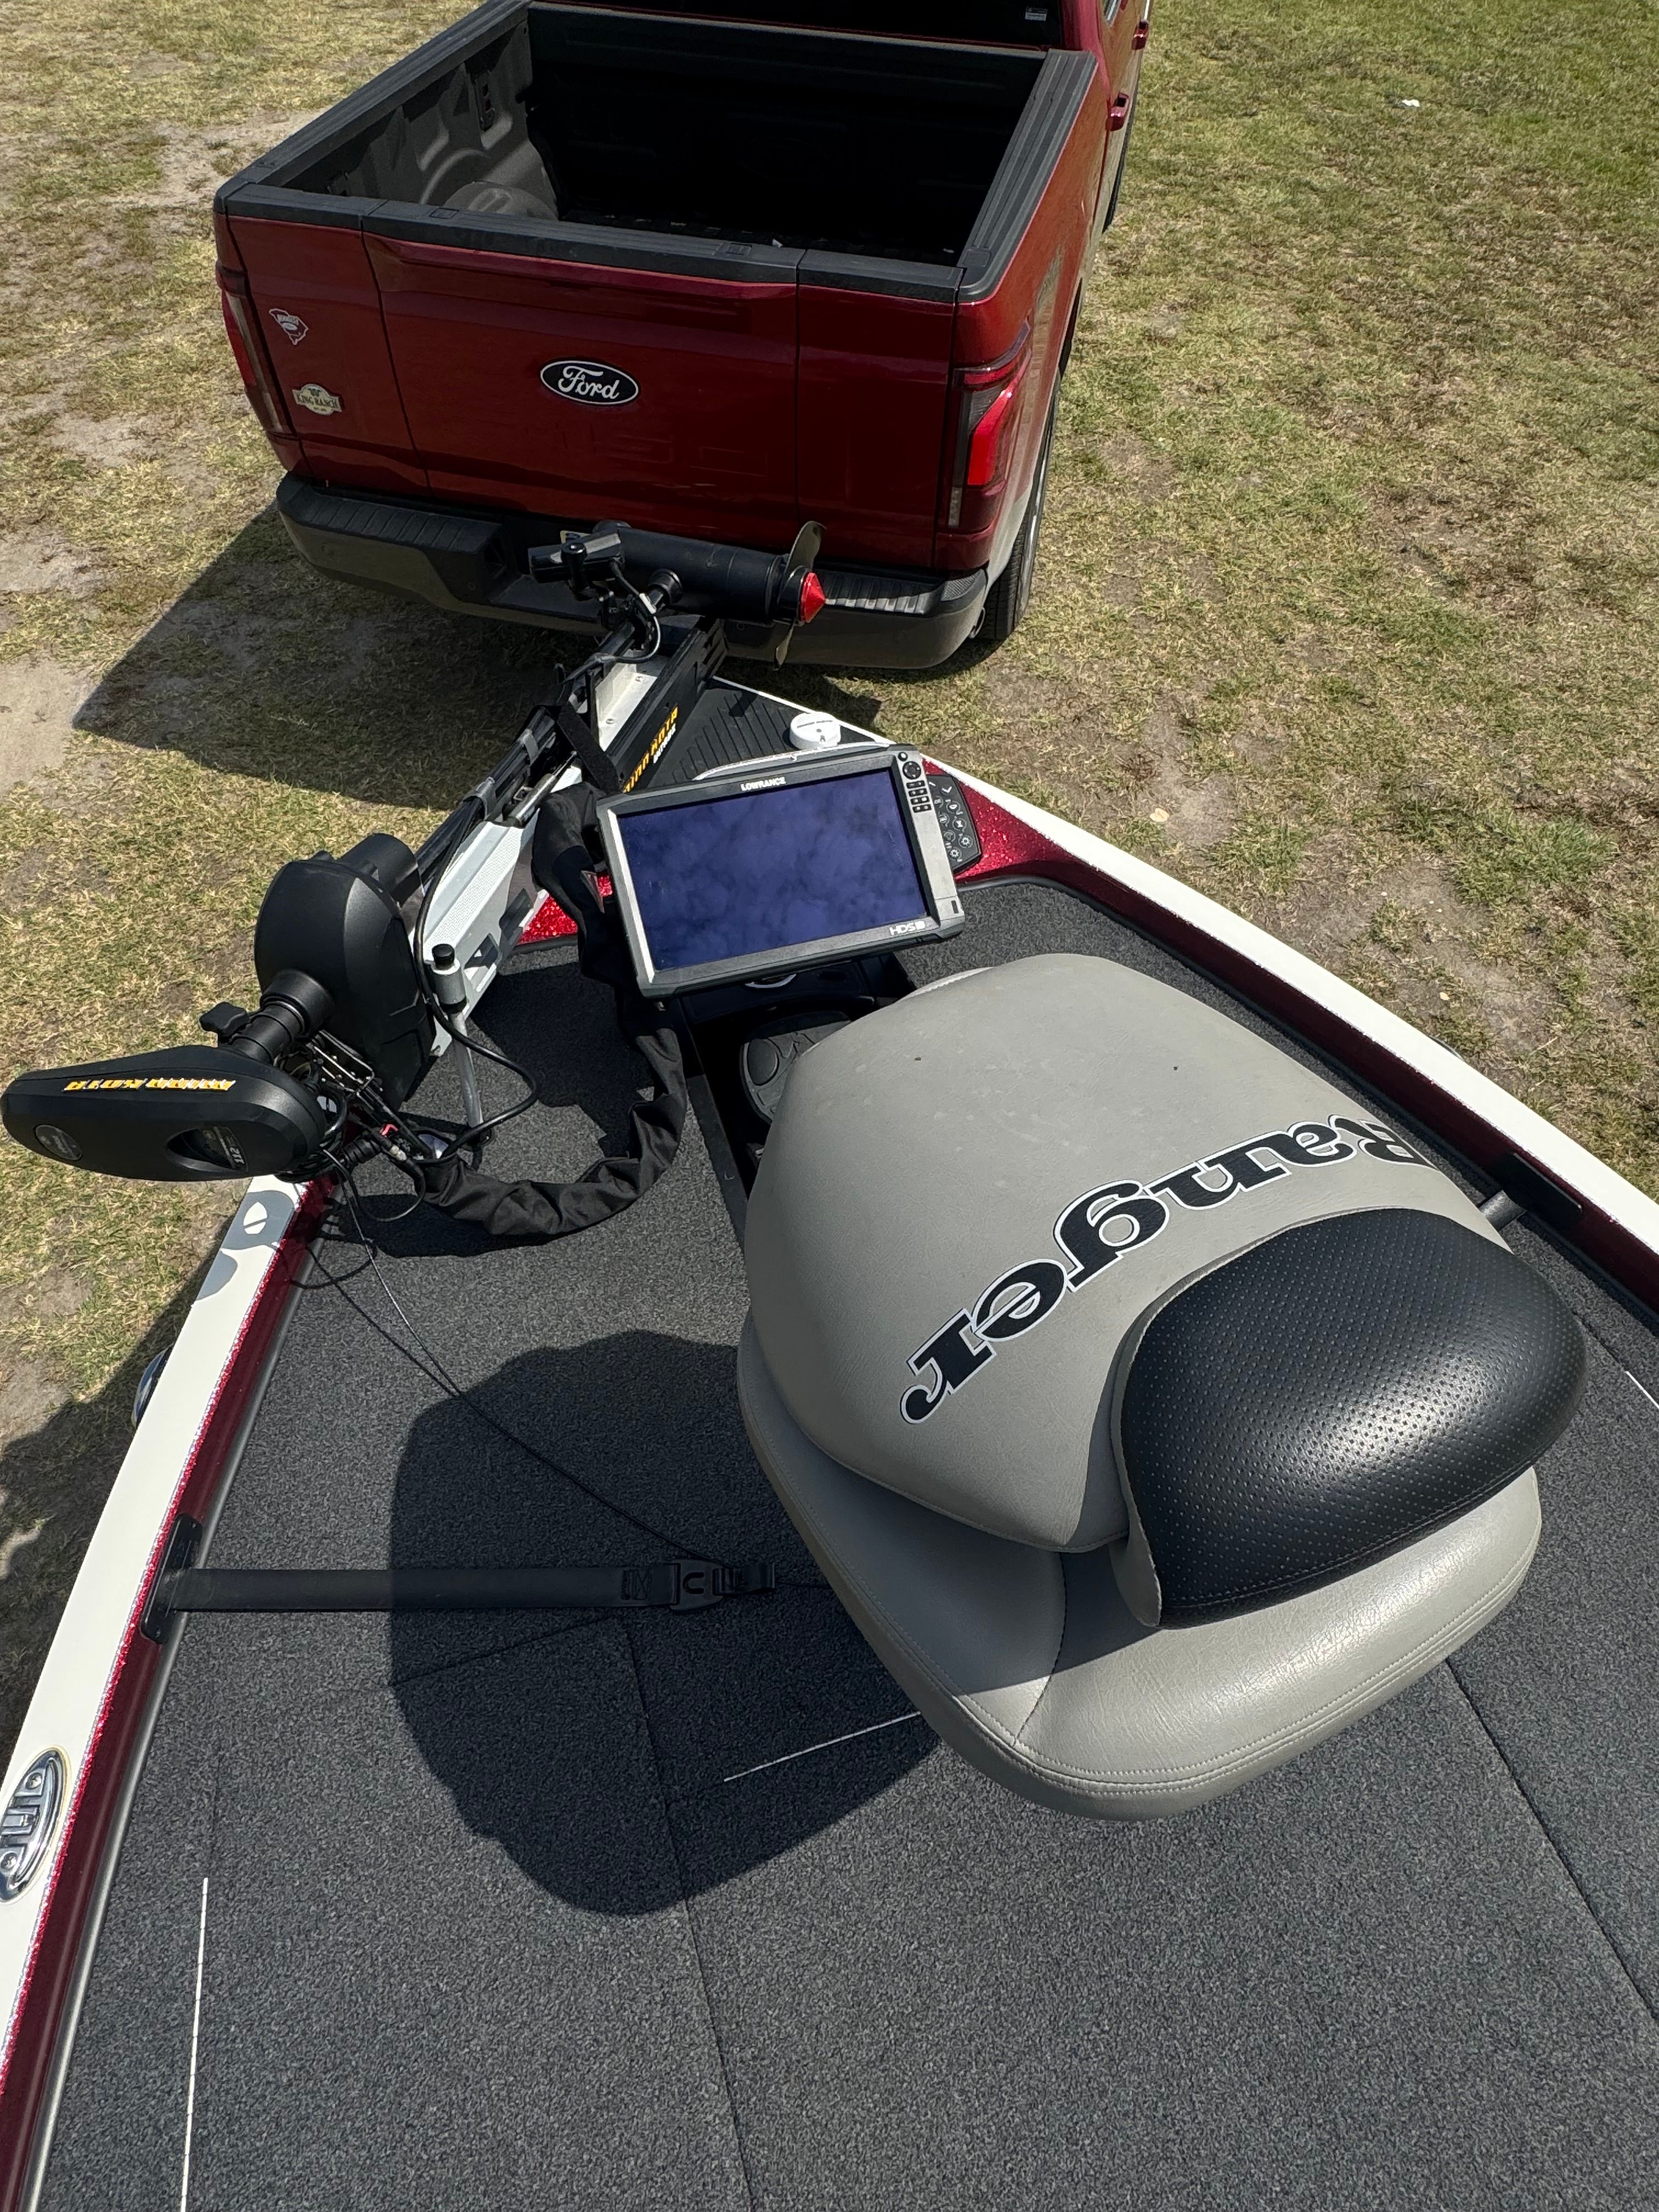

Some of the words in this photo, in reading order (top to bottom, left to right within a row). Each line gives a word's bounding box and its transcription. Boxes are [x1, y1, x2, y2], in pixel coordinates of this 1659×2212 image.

[558, 365, 620, 399] Ford
[741, 777, 787, 791] LOWRANCE
[230, 1147, 245, 1164] 112
[900, 1114, 1440, 1425] Ranger
